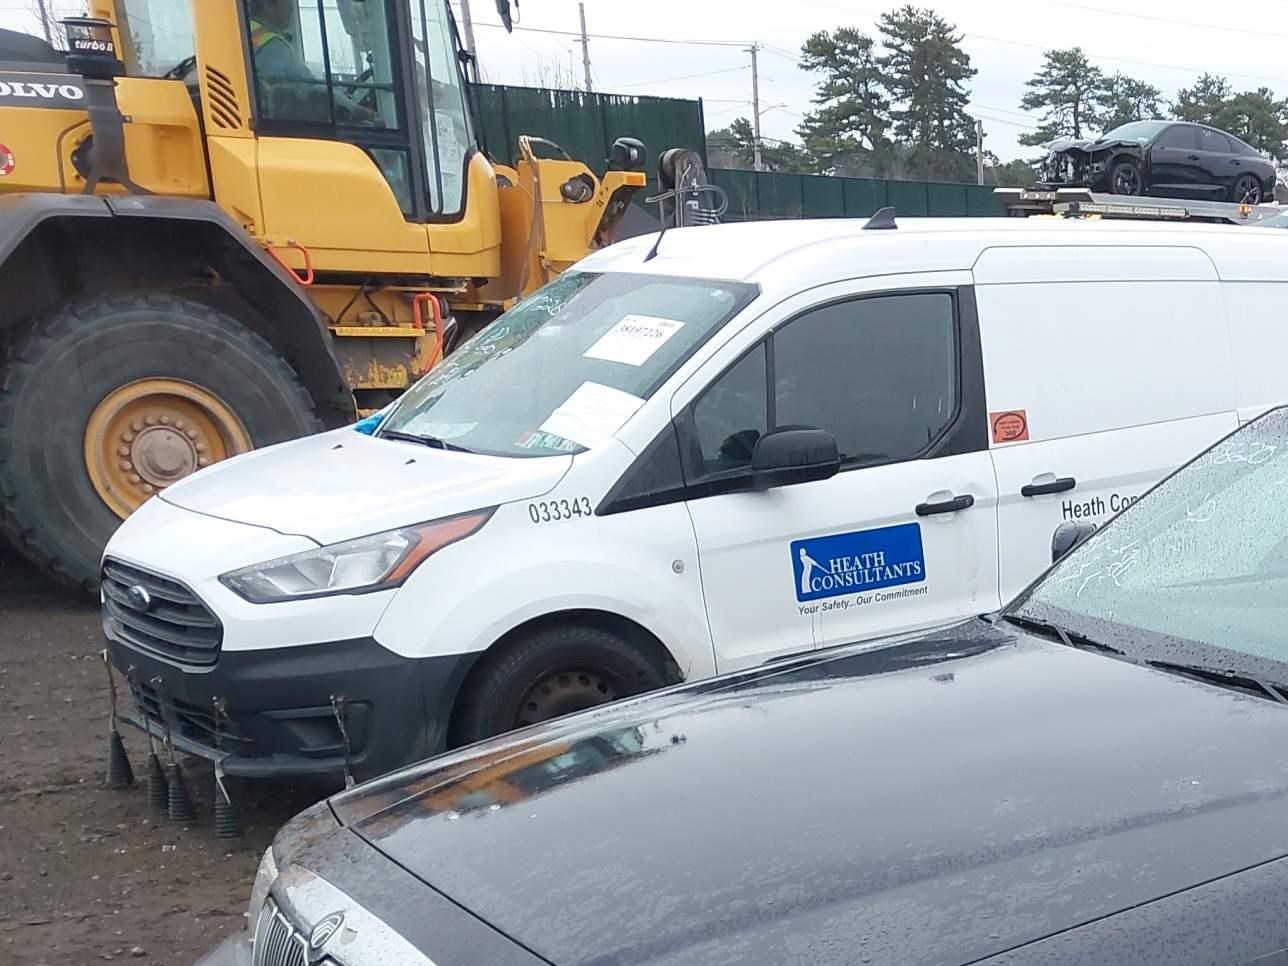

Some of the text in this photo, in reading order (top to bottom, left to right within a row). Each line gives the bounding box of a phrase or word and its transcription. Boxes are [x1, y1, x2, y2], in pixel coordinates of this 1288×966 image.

[74, 40, 105, 51] turbo
[528, 496, 592, 524] 033343
[1061, 496, 1106, 520] Heath
[811, 560, 921, 592] CONSULTANTS
[829, 551, 885, 575] HEATH
[798, 604, 820, 616] Your
[874, 585, 929, 603] Commitment
